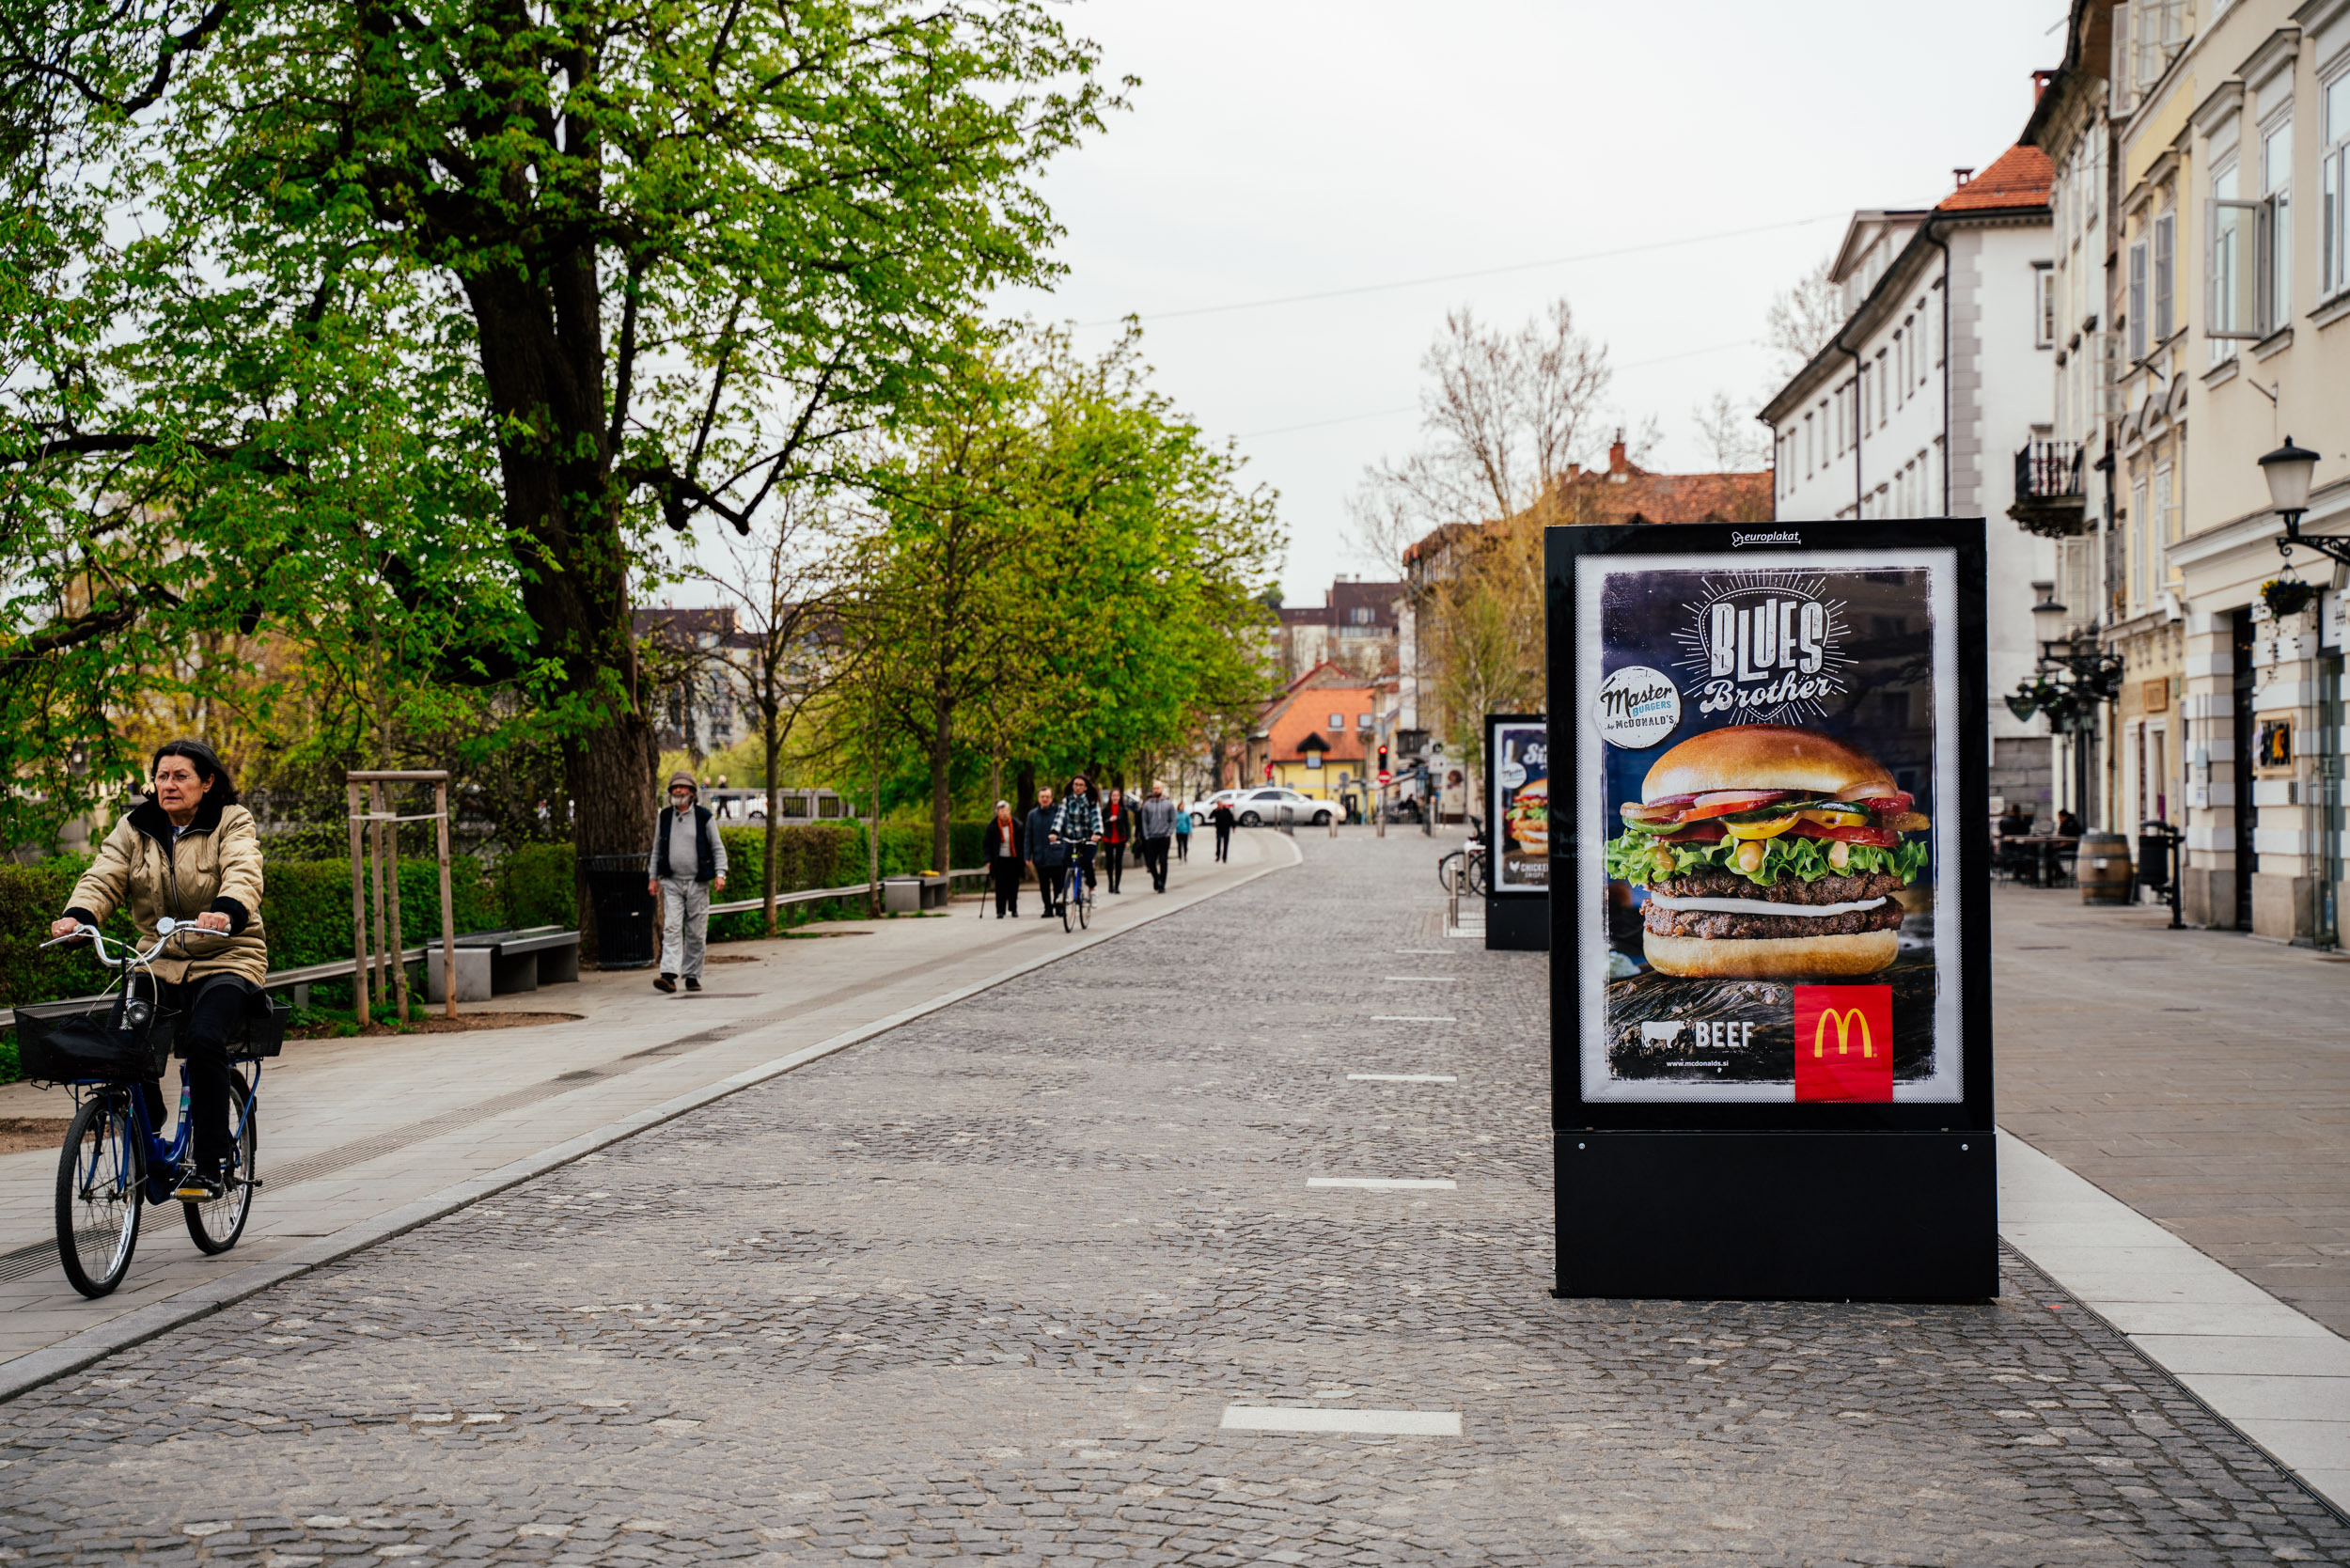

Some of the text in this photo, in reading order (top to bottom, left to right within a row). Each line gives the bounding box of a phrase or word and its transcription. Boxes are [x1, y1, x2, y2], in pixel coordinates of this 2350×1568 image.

[1744, 531, 1799, 542] europlakat
[1711, 598, 1824, 682] BLUES
[1600, 683, 1672, 718] Master
[1700, 670, 1832, 713] Brother
[1632, 700, 1672, 717] BURGERS
[1520, 862, 1549, 872] CHICKE
[1695, 1021, 1756, 1048] BEEF
